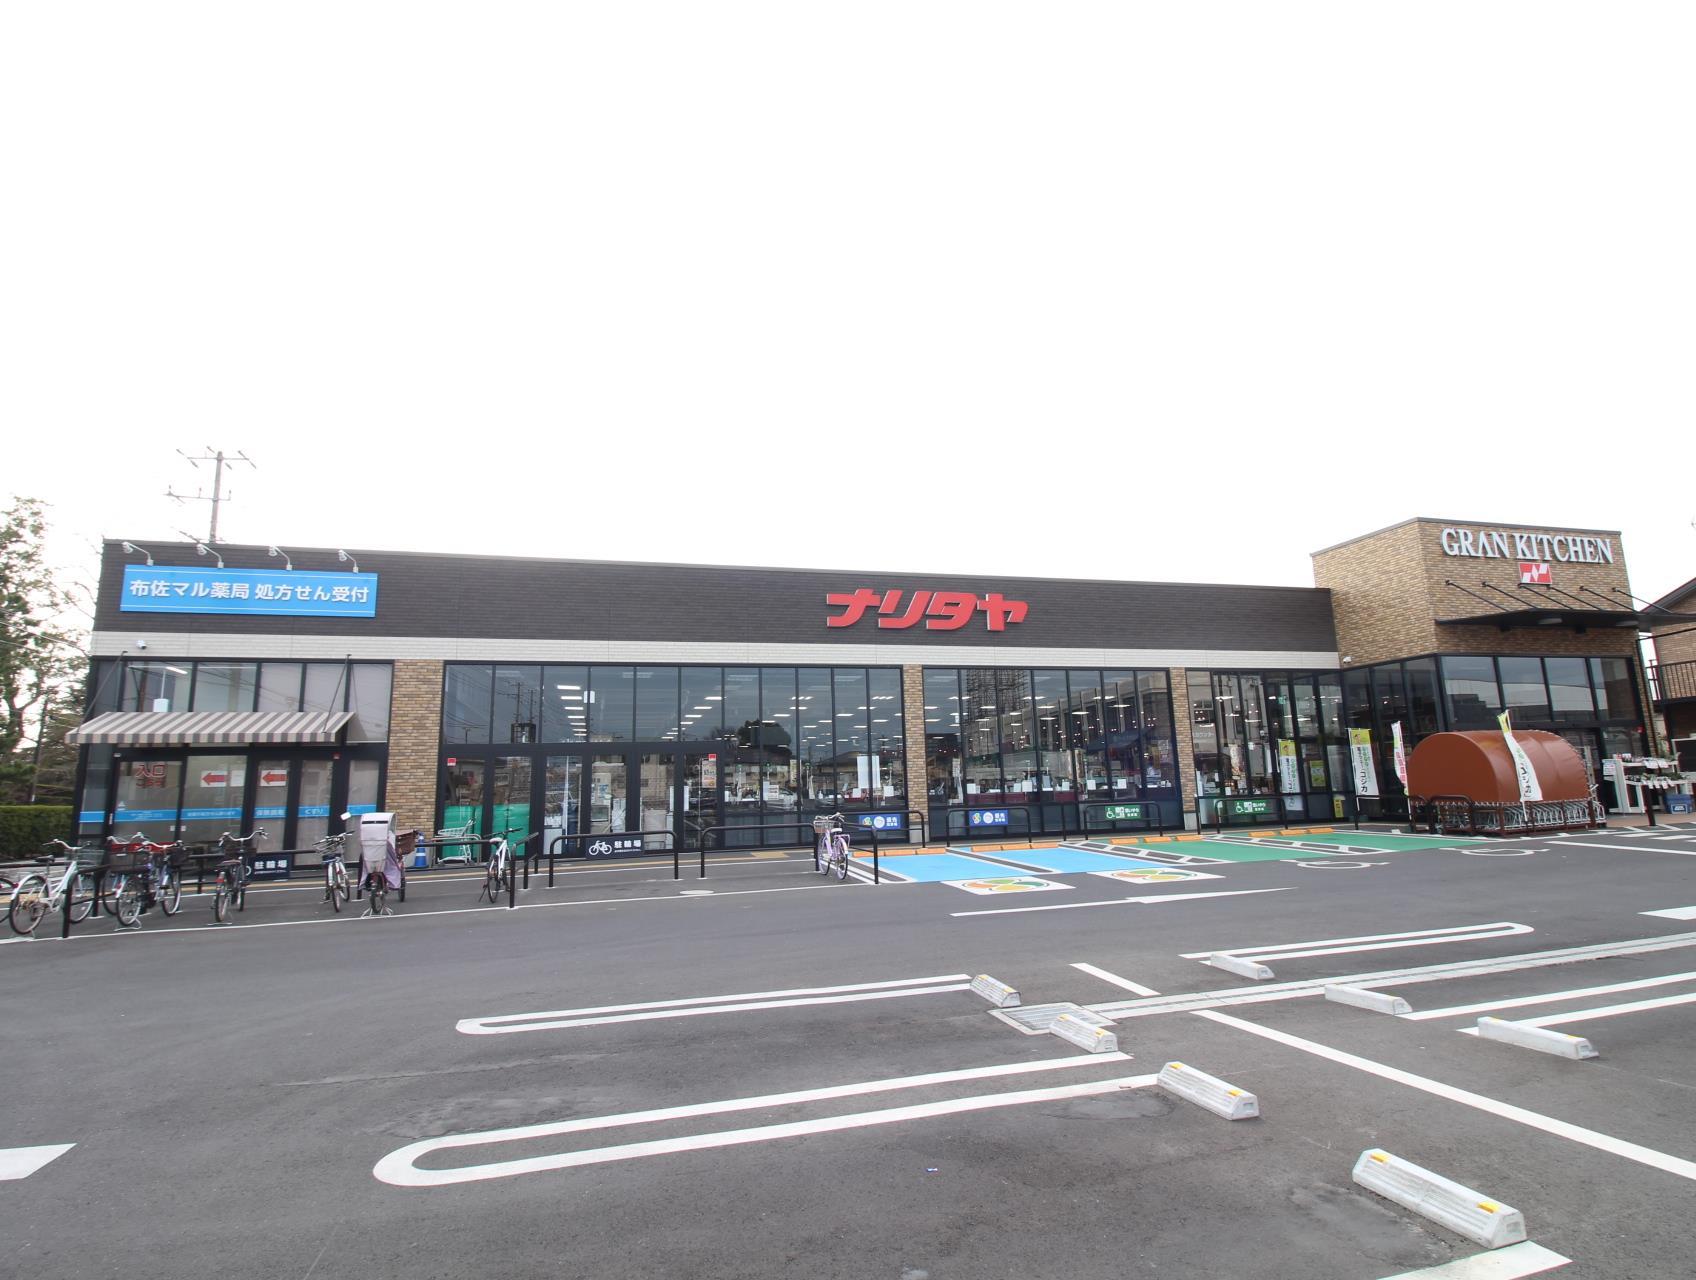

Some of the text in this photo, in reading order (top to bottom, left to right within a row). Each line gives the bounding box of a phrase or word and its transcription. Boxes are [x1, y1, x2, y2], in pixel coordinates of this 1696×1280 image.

[1441, 528, 1614, 564] GRAN KITCHEN
[129, 579, 370, 603] 布佐マル薬局 処方せん受付
[827, 588, 1029, 632] ナリタヤ
